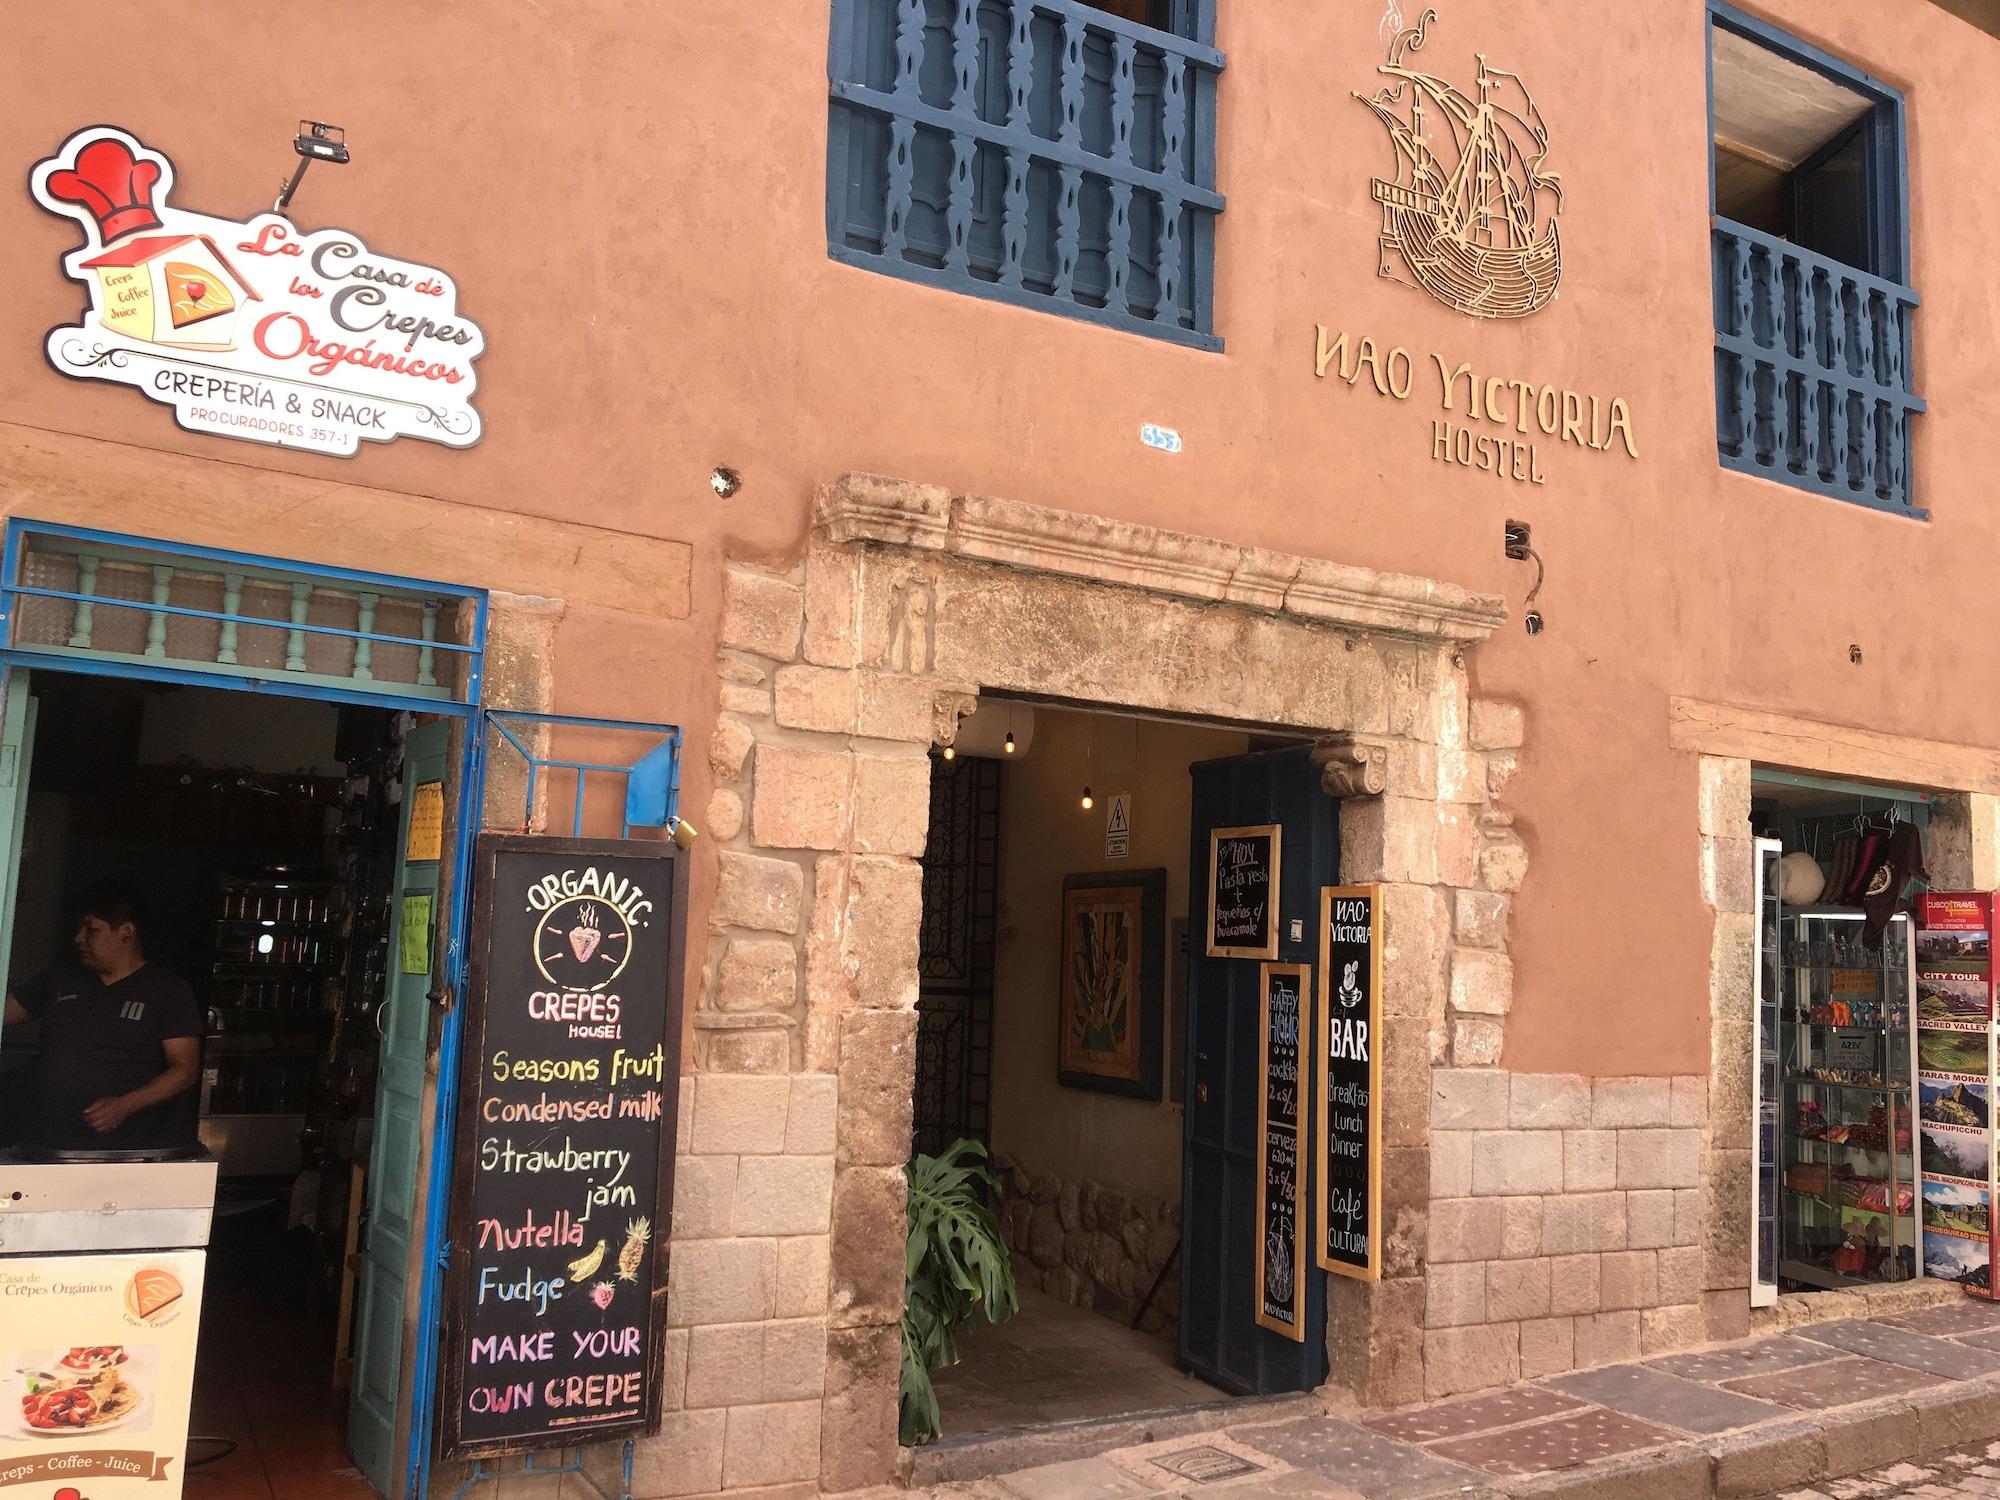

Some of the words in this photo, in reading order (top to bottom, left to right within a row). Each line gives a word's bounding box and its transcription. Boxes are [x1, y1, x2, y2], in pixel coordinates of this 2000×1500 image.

[237, 223, 304, 256] La
[311, 241, 413, 288] Casa
[105, 273, 133, 287] Creps
[117, 287, 149, 303] Coffee
[110, 307, 137, 320] Juice
[288, 276, 324, 299] los
[330, 284, 473, 347] Crepes
[253, 311, 465, 384] Orgánicos
[154, 370, 275, 411] CREPERÍA
[285, 392, 301, 414] &
[311, 398, 387, 430] SNACK
[1314, 323, 1413, 400] NAO
[1431, 352, 1640, 460] VICTORIA
[190, 407, 304, 437] PROCURADORES
[310, 427, 349, 446] 357-1
[1432, 418, 1545, 485] HOSTEL
[1232, 842, 1255, 865] HOY
[1219, 867, 1245, 889] Pasta
[1248, 866, 1268, 885] pesto
[527, 867, 653, 928] ORGANIC
[1953, 901, 1978, 909] TRAVEL
[1336, 900, 1364, 923] NAO
[1331, 923, 1371, 943] VICTORIA
[1924, 972, 1948, 980] CITY
[1951, 973, 1980, 981] TOUR
[120, 1000, 145, 1021] 10
[528, 991, 621, 1023] CREPES
[1269, 992, 1298, 1014] HAPPY
[1269, 1013, 1299, 1045] HOUR
[1917, 1020, 1951, 1030] SACRED
[1953, 1022, 1988, 1032] VALLEY
[1330, 1018, 1368, 1062] BAR
[492, 1050, 600, 1083] Seasons
[1919, 1071, 1950, 1081] MARAS
[1952, 1074, 1988, 1084] MORAY
[483, 1091, 614, 1123] Condensed
[618, 1090, 663, 1122] milk
[1334, 1110, 1363, 1133] Lunch
[1921, 1122, 1983, 1135] MACHUPICCHU
[1331, 1133, 1363, 1158] Dinner
[480, 1136, 631, 1187] Strawberry
[578, 1177, 636, 1223] jam
[1331, 1188, 1364, 1231] Café
[1923, 1225, 1970, 1240] OQUEQUIRAO
[0, 1272, 23, 1284] Casa
[27, 1271, 41, 1283] de
[52, 1281, 113, 1296] Orgánicos
[478, 1266, 565, 1317] Fudge
[470, 1331, 555, 1365] MAKE
[572, 1326, 641, 1360] YOUR
[469, 1381, 535, 1414] OWN
[544, 1371, 642, 1408] CREPE
[47, 1454, 92, 1471] Coffee
[104, 1456, 142, 1473] Juice
